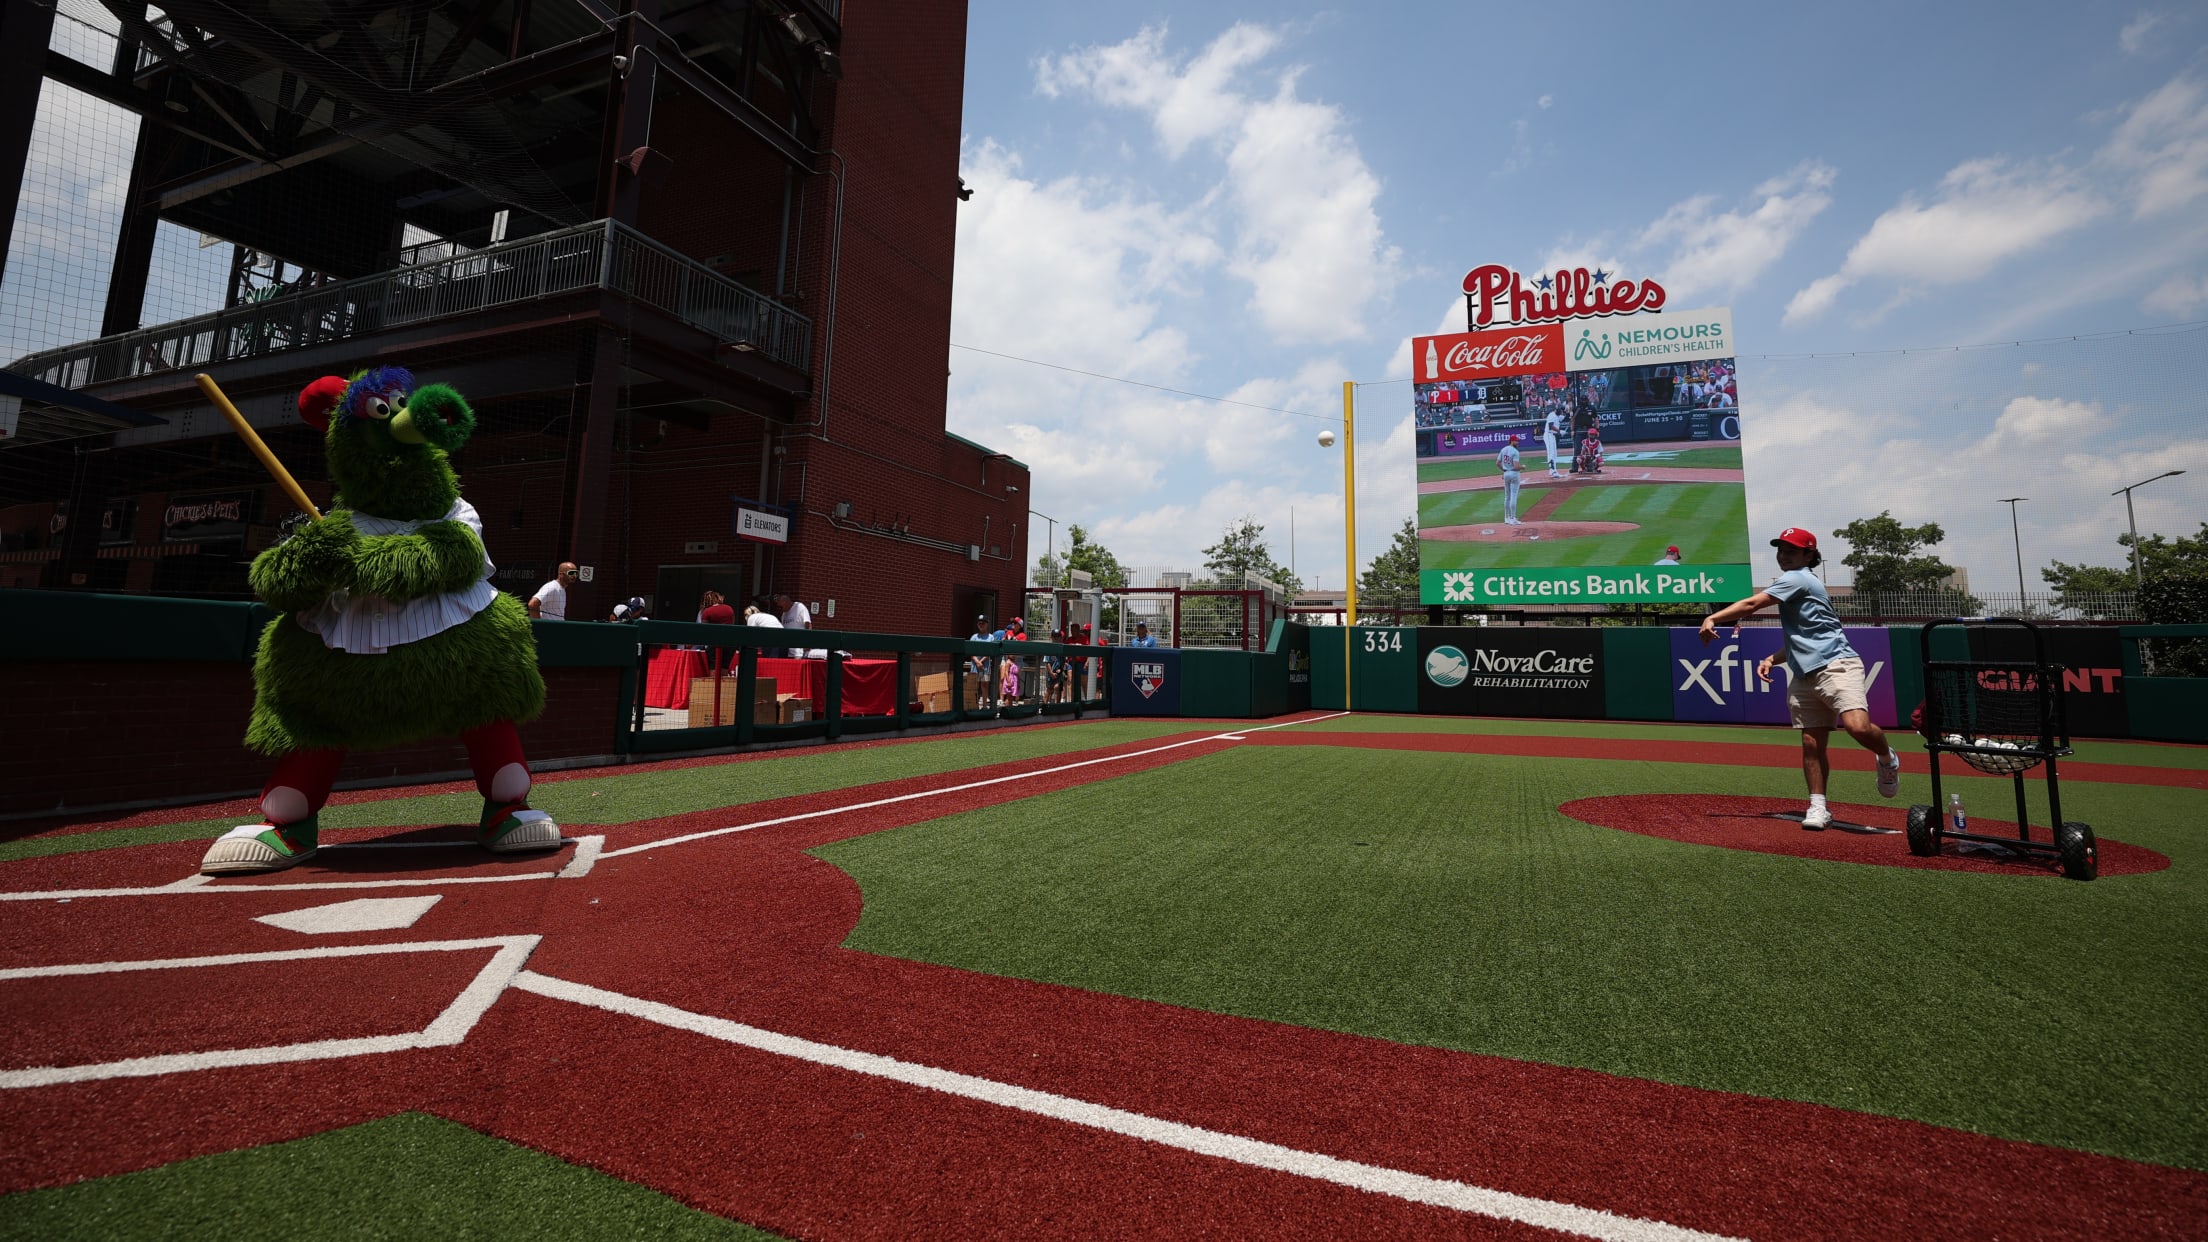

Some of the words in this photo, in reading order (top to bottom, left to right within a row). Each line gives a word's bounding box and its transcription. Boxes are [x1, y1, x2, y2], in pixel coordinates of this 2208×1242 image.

[1462, 263, 1666, 327] Phillies
[1618, 323, 1722, 344] NEMOURS
[1444, 333, 1549, 372] Coca-Cola
[1618, 343, 1680, 358] CHILDREN'S
[1683, 339, 1724, 352] HEALTH
[1597, 412, 1622, 421] OCKET
[1462, 432, 1493, 445] planet
[1493, 431, 1527, 441] fitnss
[213, 500, 241, 520] PETE'S
[754, 518, 782, 533] ELEVATORS
[1483, 576, 1581, 596] Citizens
[1587, 573, 1651, 595] Bank
[1657, 572, 1716, 594] Park
[1364, 631, 1402, 652] 334
[1133, 664, 1162, 675] MLB
[1472, 649, 1594, 674] NovaCare
[1472, 677, 1590, 689] REHABILITATION
[1678, 645, 1885, 705] xfin
